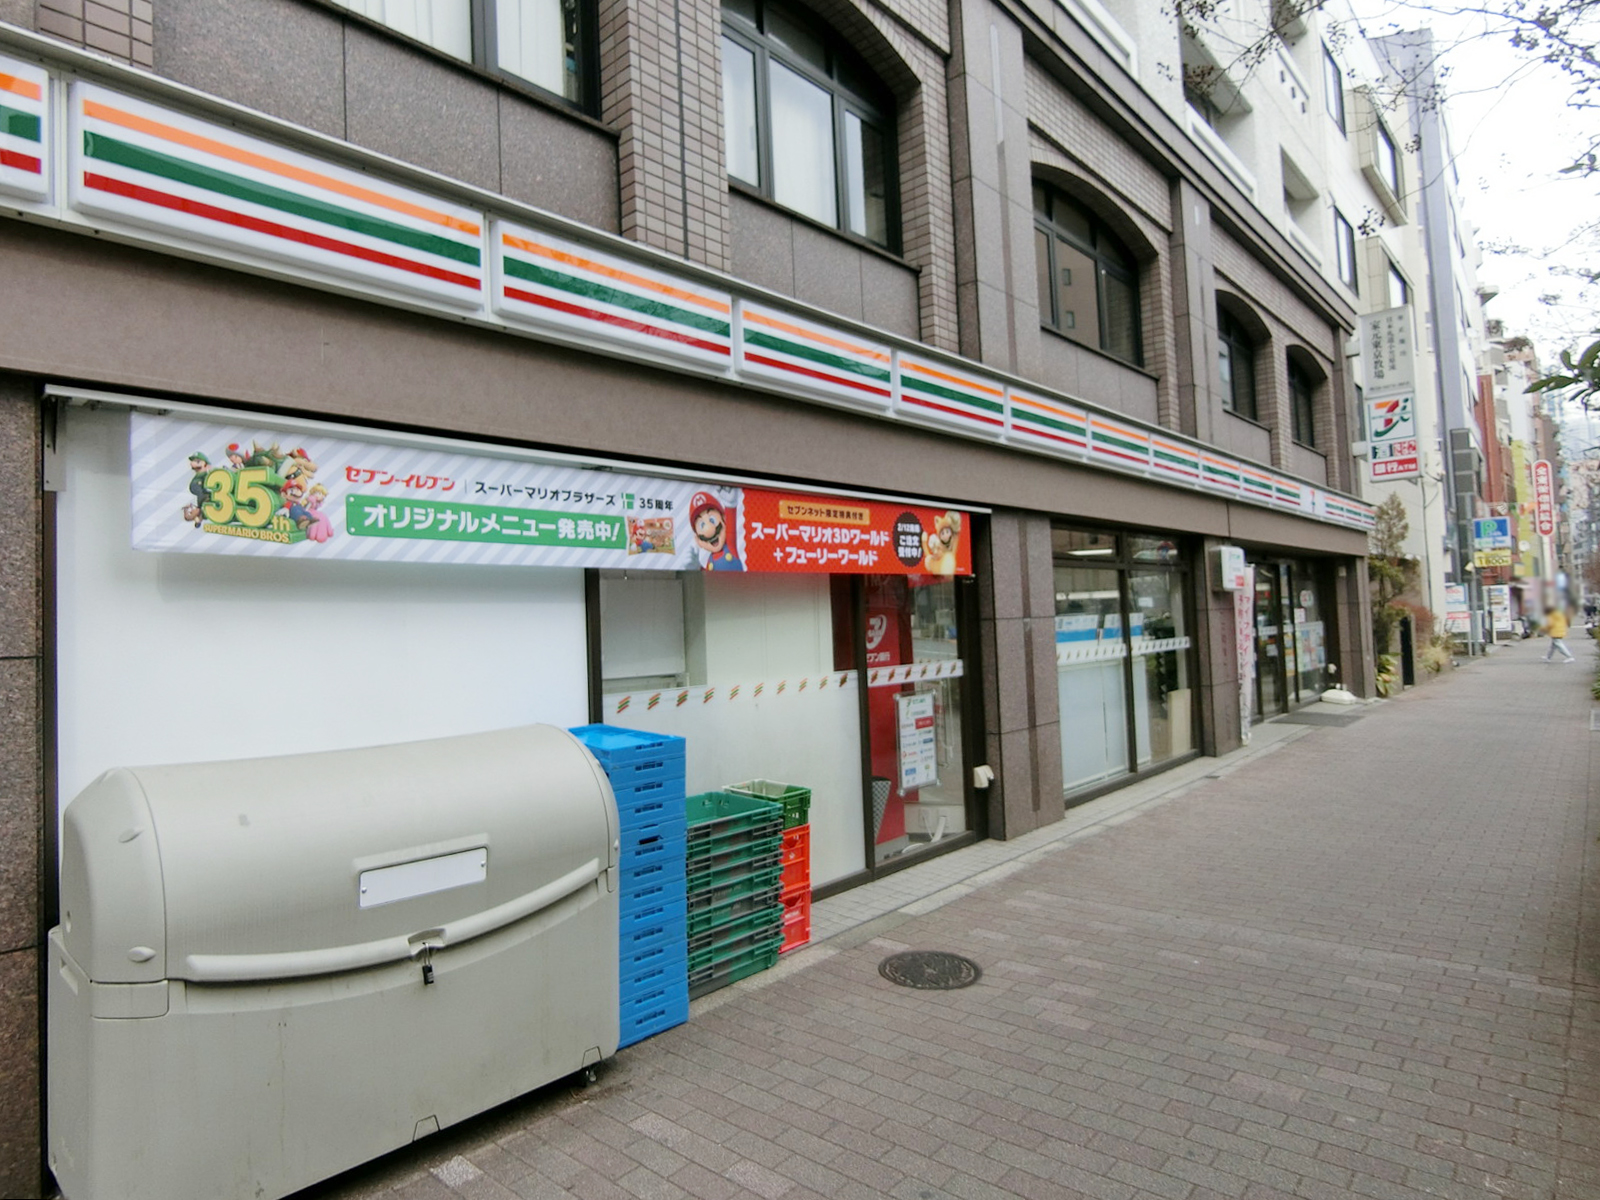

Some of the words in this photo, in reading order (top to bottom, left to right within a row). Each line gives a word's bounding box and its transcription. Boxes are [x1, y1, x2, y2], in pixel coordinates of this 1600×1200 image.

[345, 465, 456, 492] セブン-イレブン
[474, 480, 616, 507] スーパーマリオブラザーズ
[638, 497, 674, 512] 35周年
[203, 524, 228, 535] SUPER
[227, 527, 260, 539] MARIO
[363, 503, 621, 542] オリジナルメニュー発売中!
[751, 521, 890, 547] スーパーマリオ3Dワールド
